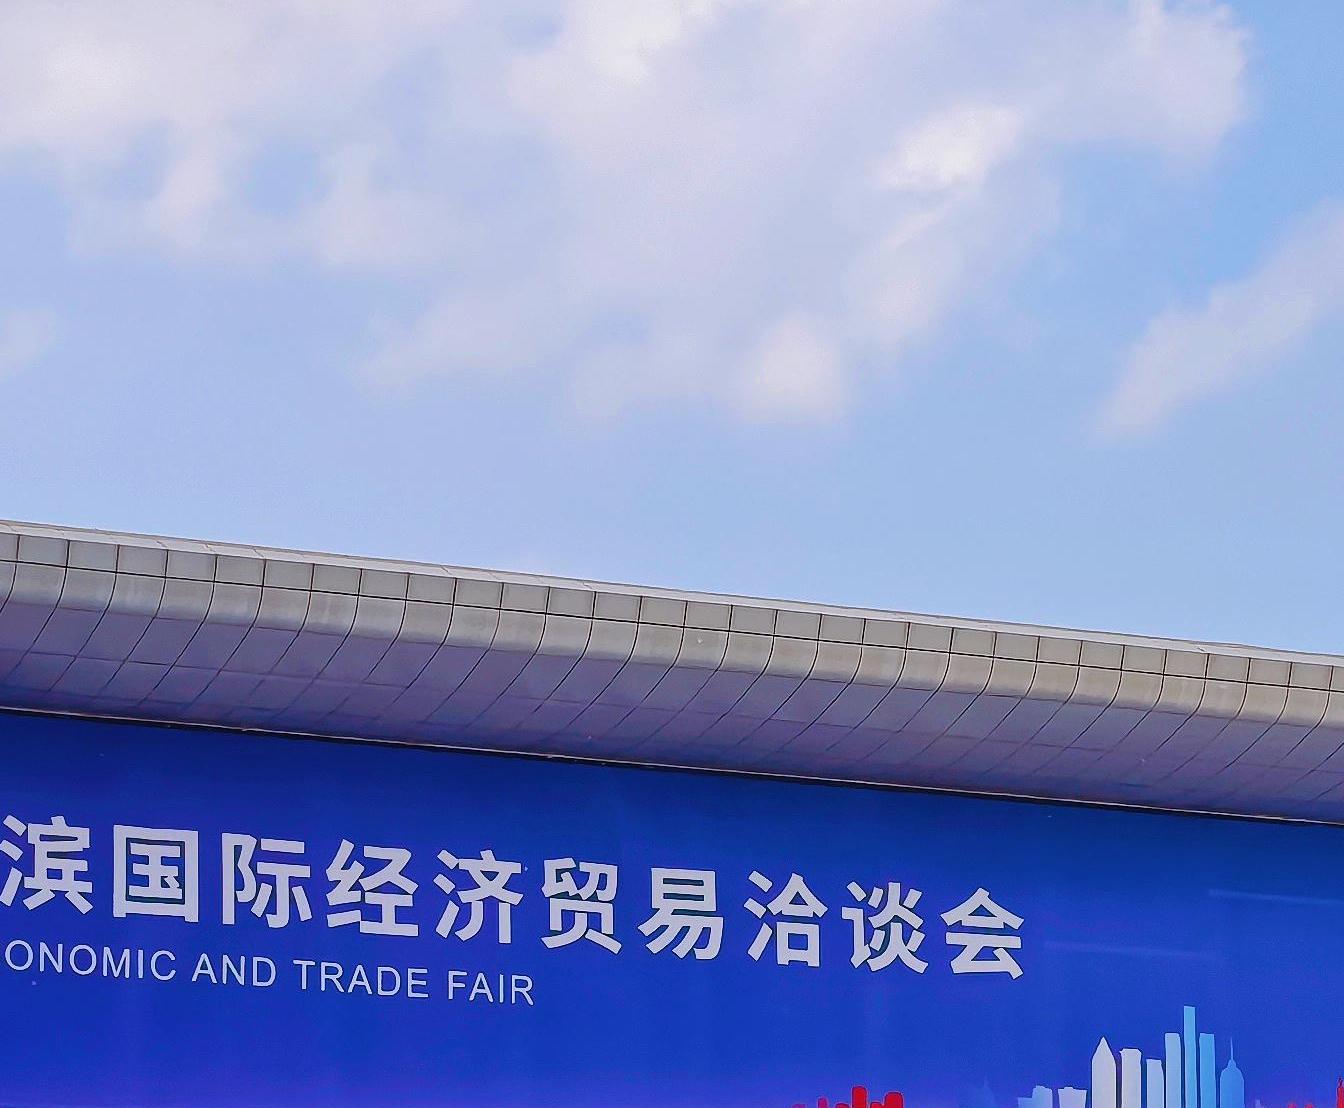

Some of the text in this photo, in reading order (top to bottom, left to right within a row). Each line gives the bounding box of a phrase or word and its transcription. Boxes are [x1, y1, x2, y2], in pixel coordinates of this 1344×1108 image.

[192, 953, 277, 988] AND
[293, 960, 430, 999] TRADE
[447, 971, 535, 1006] FAIR
